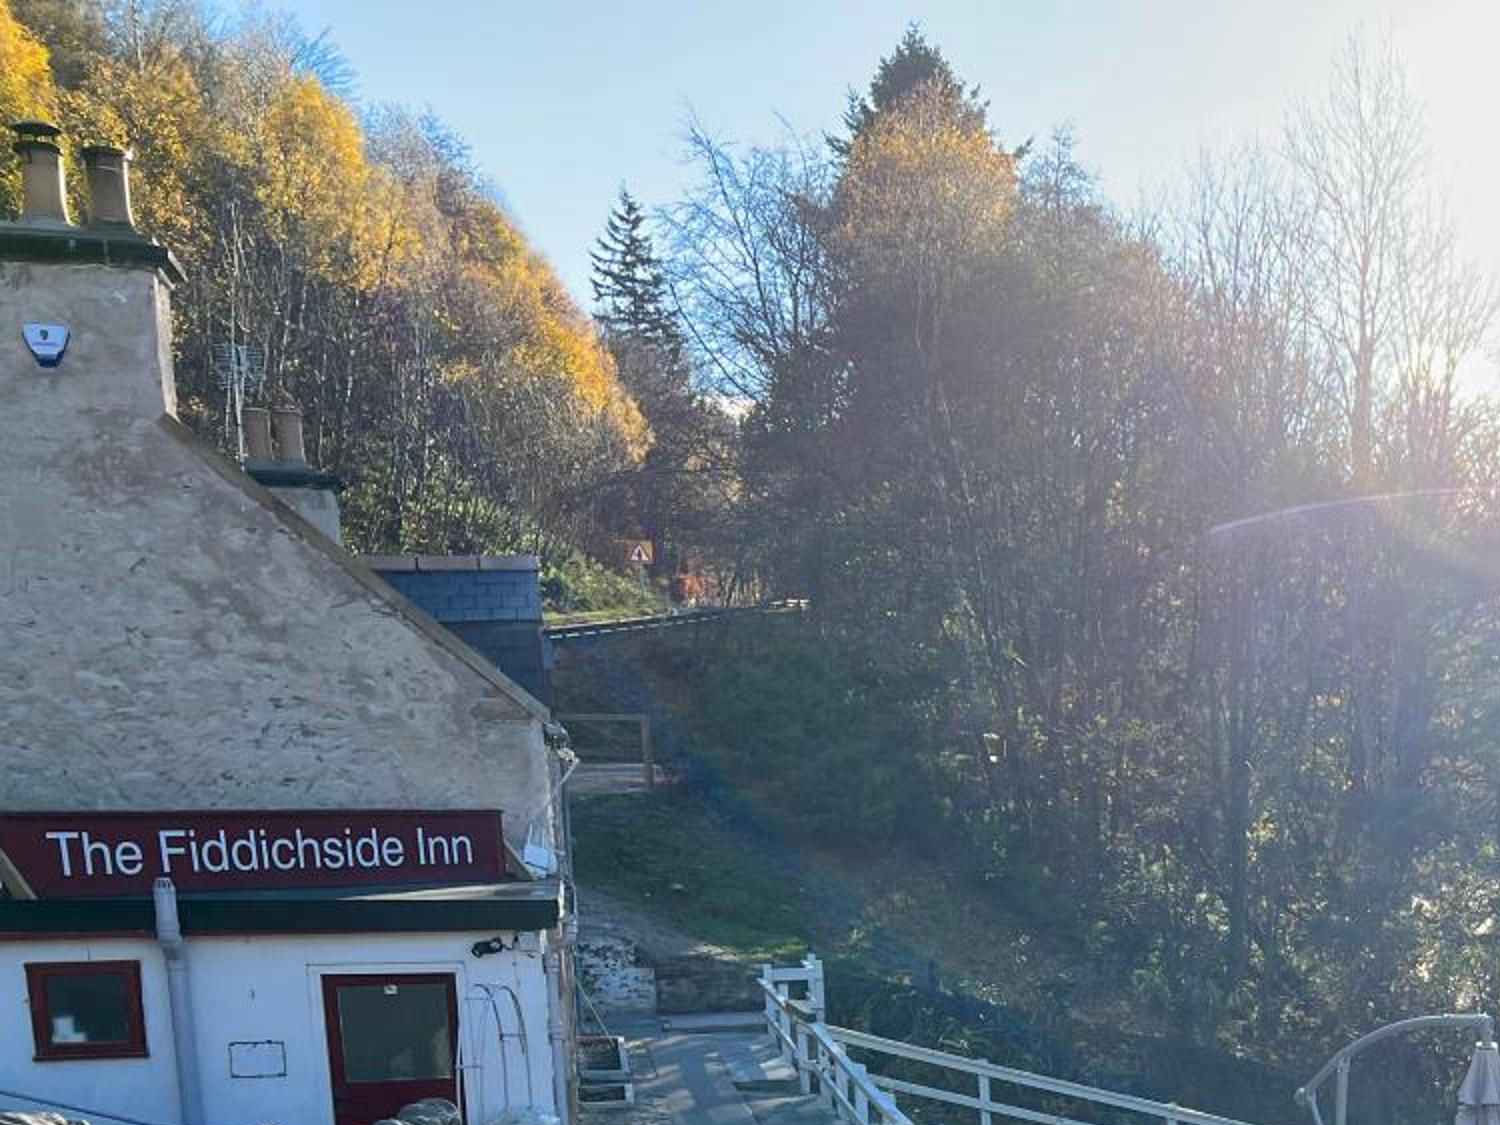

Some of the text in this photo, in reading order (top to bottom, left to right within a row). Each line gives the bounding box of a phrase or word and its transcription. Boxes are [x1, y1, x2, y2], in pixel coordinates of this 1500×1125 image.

[46, 827, 472, 877] The Fiddichside Inn
